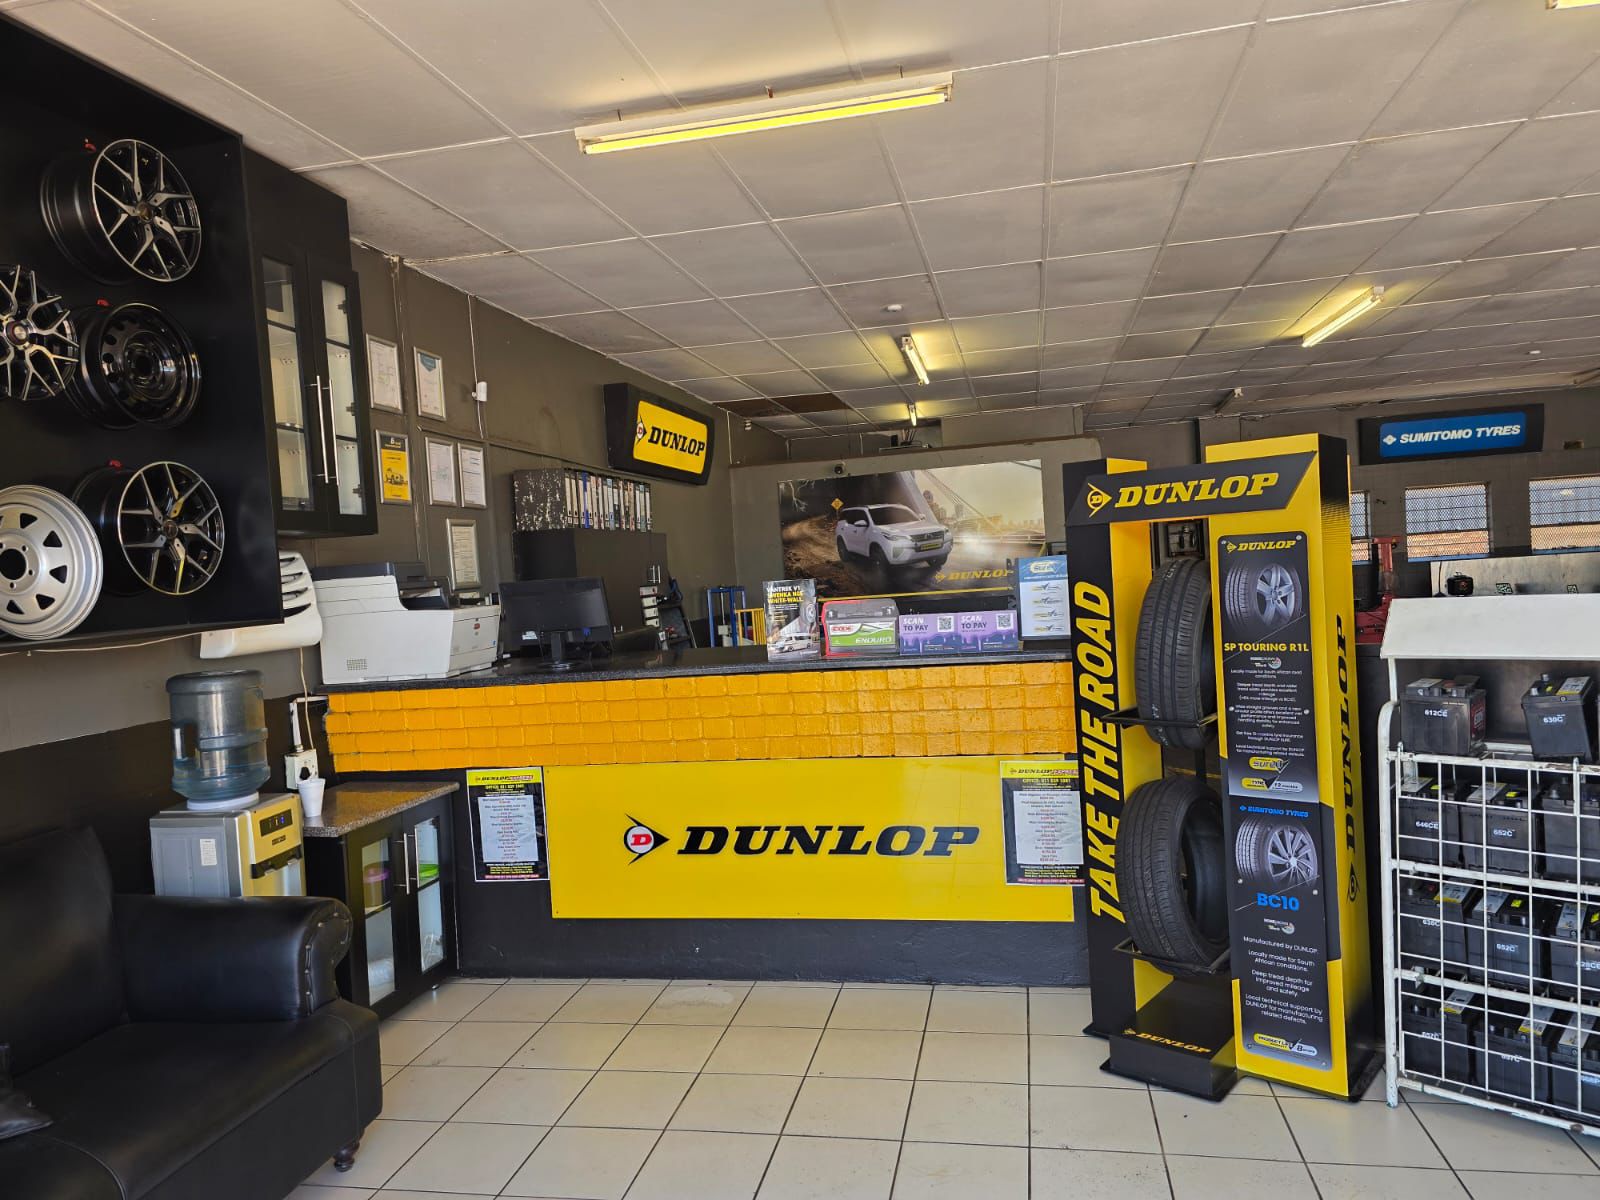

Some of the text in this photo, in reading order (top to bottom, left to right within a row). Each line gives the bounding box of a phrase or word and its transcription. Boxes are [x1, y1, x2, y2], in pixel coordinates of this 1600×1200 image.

[648, 426, 705, 456] DUNLOP
[1400, 424, 1521, 444] SUMITOMO TYRES
[1114, 472, 1279, 508] DUNLOP
[1237, 540, 1296, 551] DUNLOP
[948, 568, 1014, 581] DUNLOP
[903, 616, 924, 625] SCAN
[961, 614, 982, 623] SCAN
[972, 621, 987, 629] PAY
[903, 624, 914, 632] TO
[855, 636, 892, 644] ENDURO
[1223, 643, 1310, 652] SP TOURING R1L
[1336, 614, 1356, 854] DUNLOP
[1074, 581, 1126, 923] TAKE THE ROAD
[1247, 806, 1309, 817] SUMITOMO TYRES
[677, 825, 980, 856] DUNLOP
[1256, 892, 1300, 911] BC10
[1243, 936, 1284, 948] Manufactured
[1285, 943, 1293, 951] by
[1248, 949, 1268, 959] Locally
[1268, 953, 1286, 962] made
[1297, 958, 1315, 967] South
[1254, 957, 1276, 967] African
[1251, 969, 1268, 979] Deep
[1268, 972, 1285, 981] tread
[1285, 976, 1303, 985] depth
[1255, 976, 1310, 993] improved mileage
[1266, 985, 1279, 993] and
[1245, 993, 1322, 1015] Local technical support by
[1245, 1000, 1268, 1009] DUNLOP
[1277, 1006, 1323, 1023] manufacturing
[1261, 1009, 1283, 1019] related
[1136, 1032, 1212, 1053] DUNLOP
